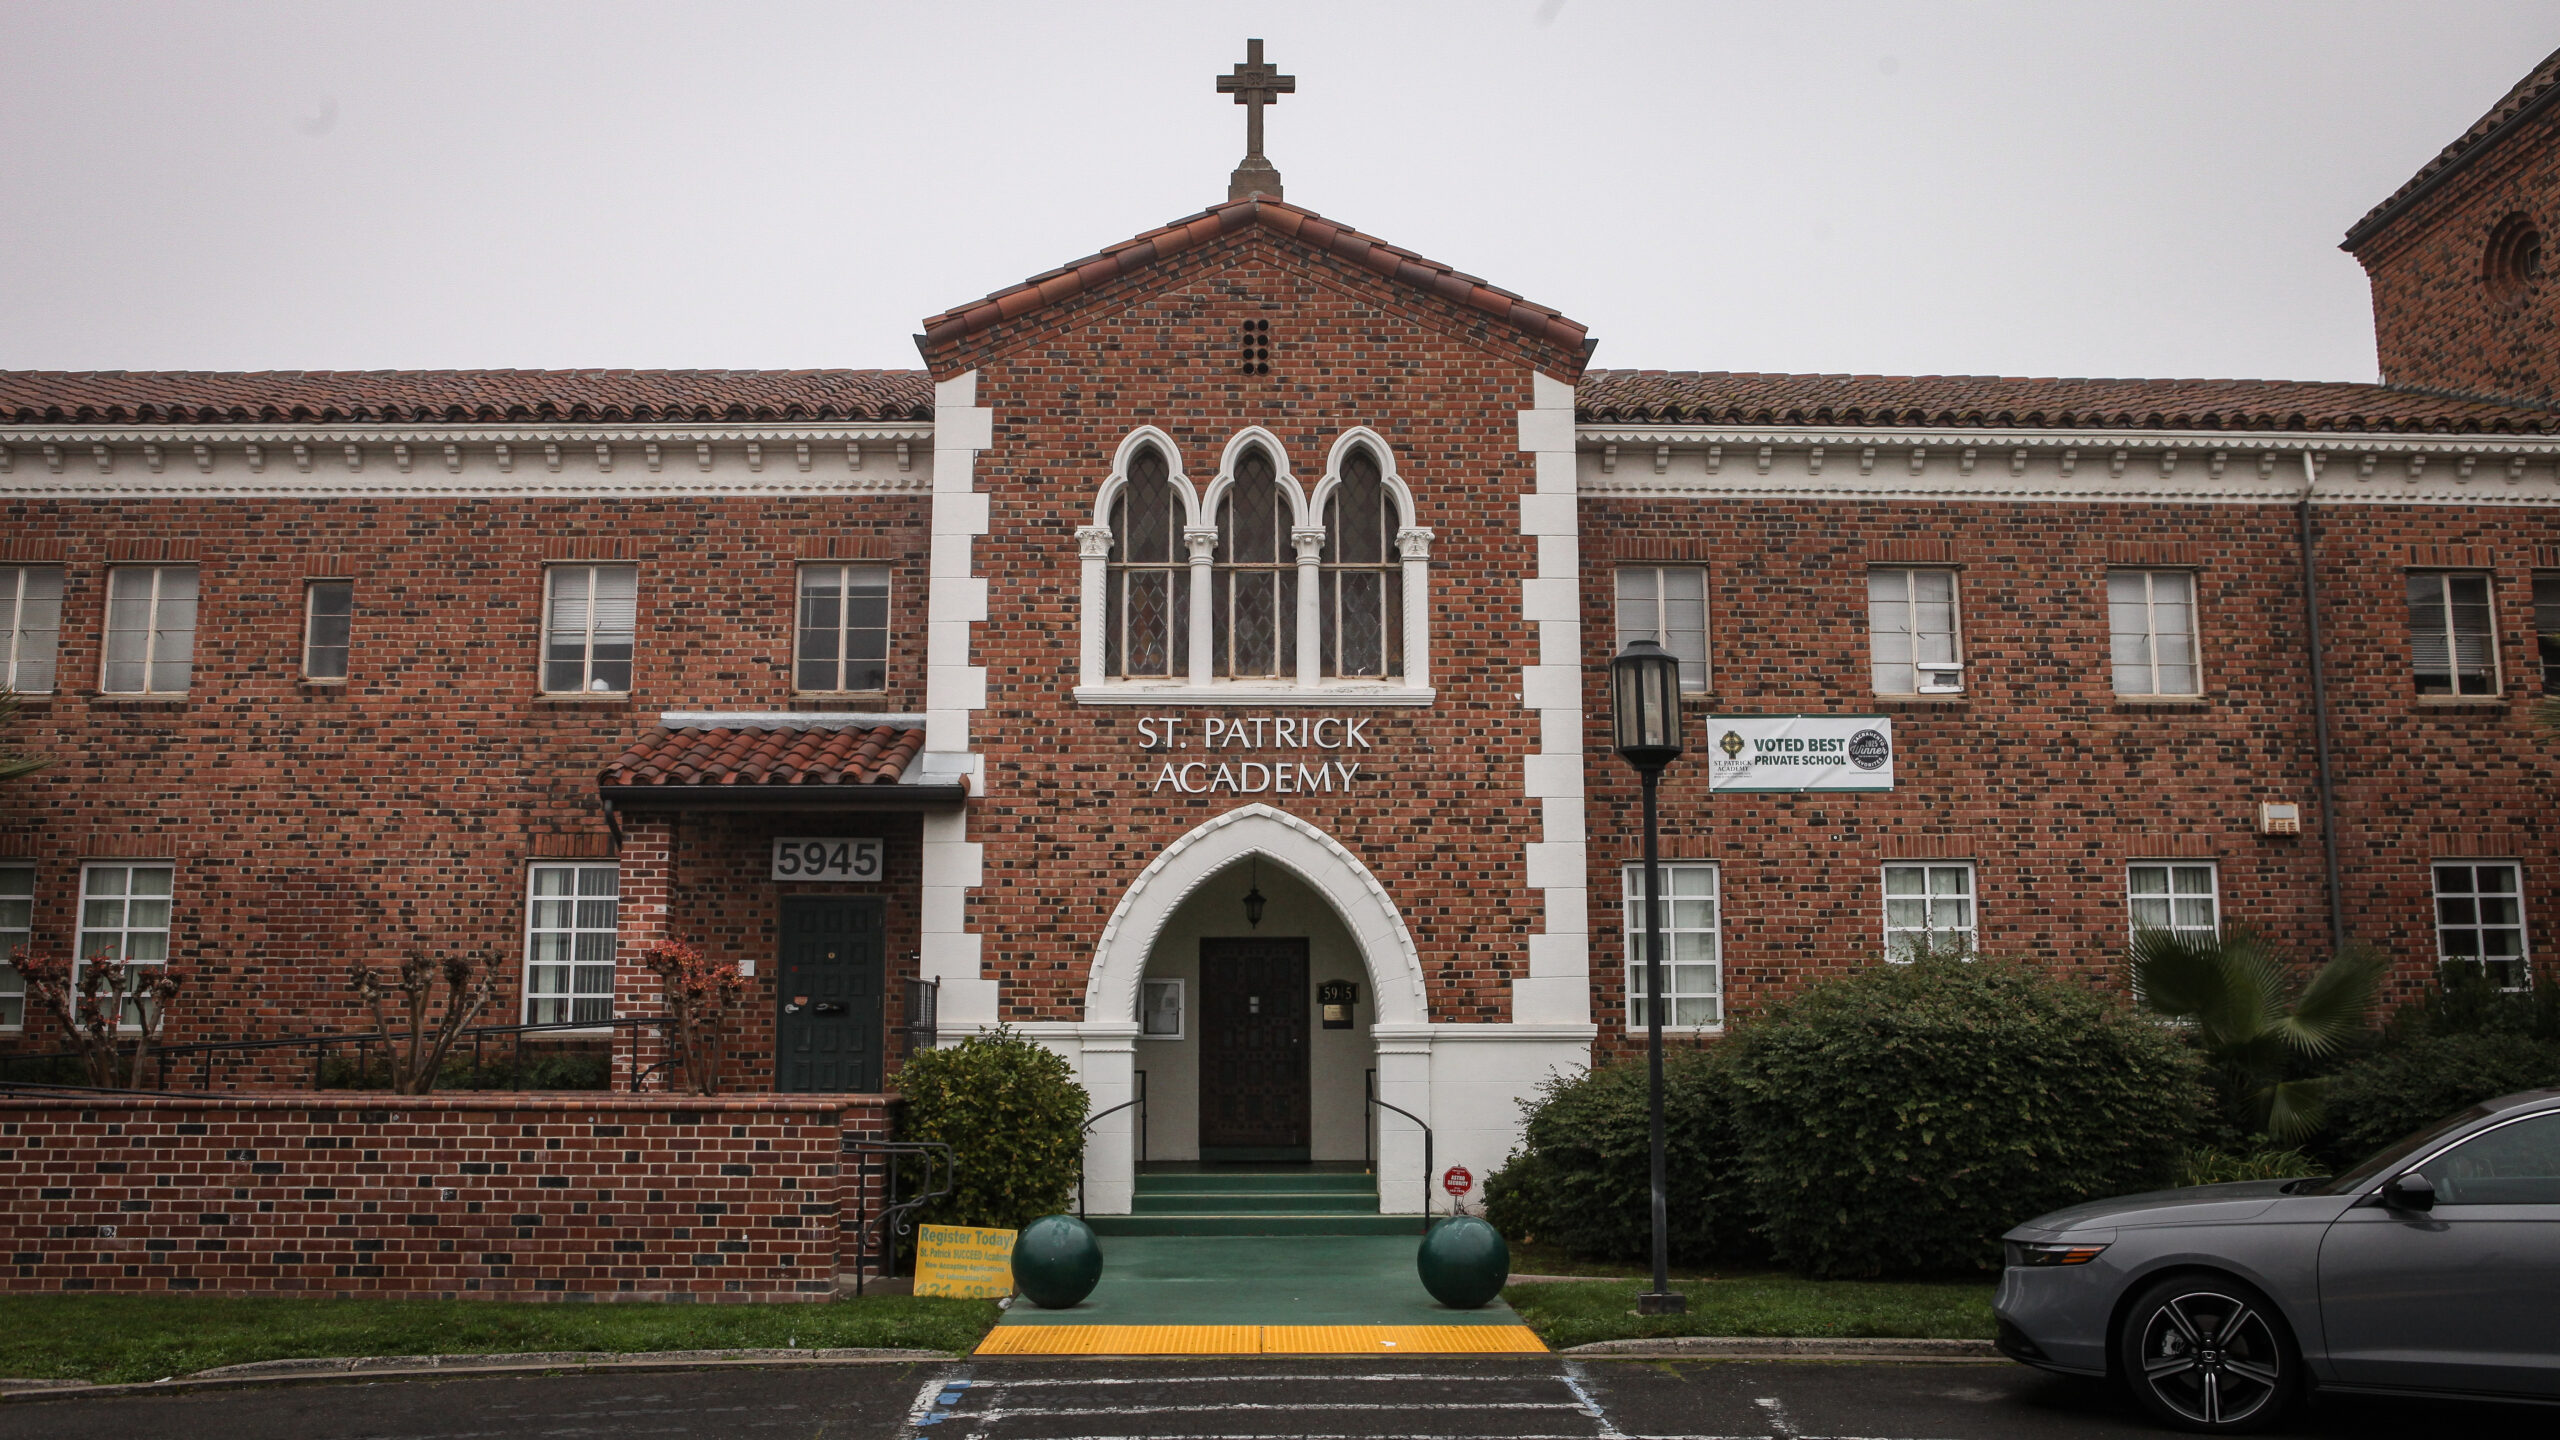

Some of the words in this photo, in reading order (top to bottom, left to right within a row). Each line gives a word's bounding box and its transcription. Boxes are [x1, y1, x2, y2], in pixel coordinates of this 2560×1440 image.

[1137, 717, 1187, 749] ST.
[1204, 717, 1371, 749] PATRICK
[1853, 731, 1886, 747] SACRAMENTO
[1753, 738, 1805, 752] VOTED
[1807, 738, 1846, 752] BEST
[1850, 743, 1888, 755] Winner
[1754, 755, 1800, 766] PRIVATE
[1801, 755, 1847, 766] SCHOOL
[1854, 757, 1884, 768] FAVORITES
[1153, 761, 1361, 794] ACADEMY
[777, 841, 878, 877] 5945
[921, 1227, 971, 1246] Register
[975, 1230, 1014, 1250] Today!
[930, 1248, 951, 1258] Patrick
